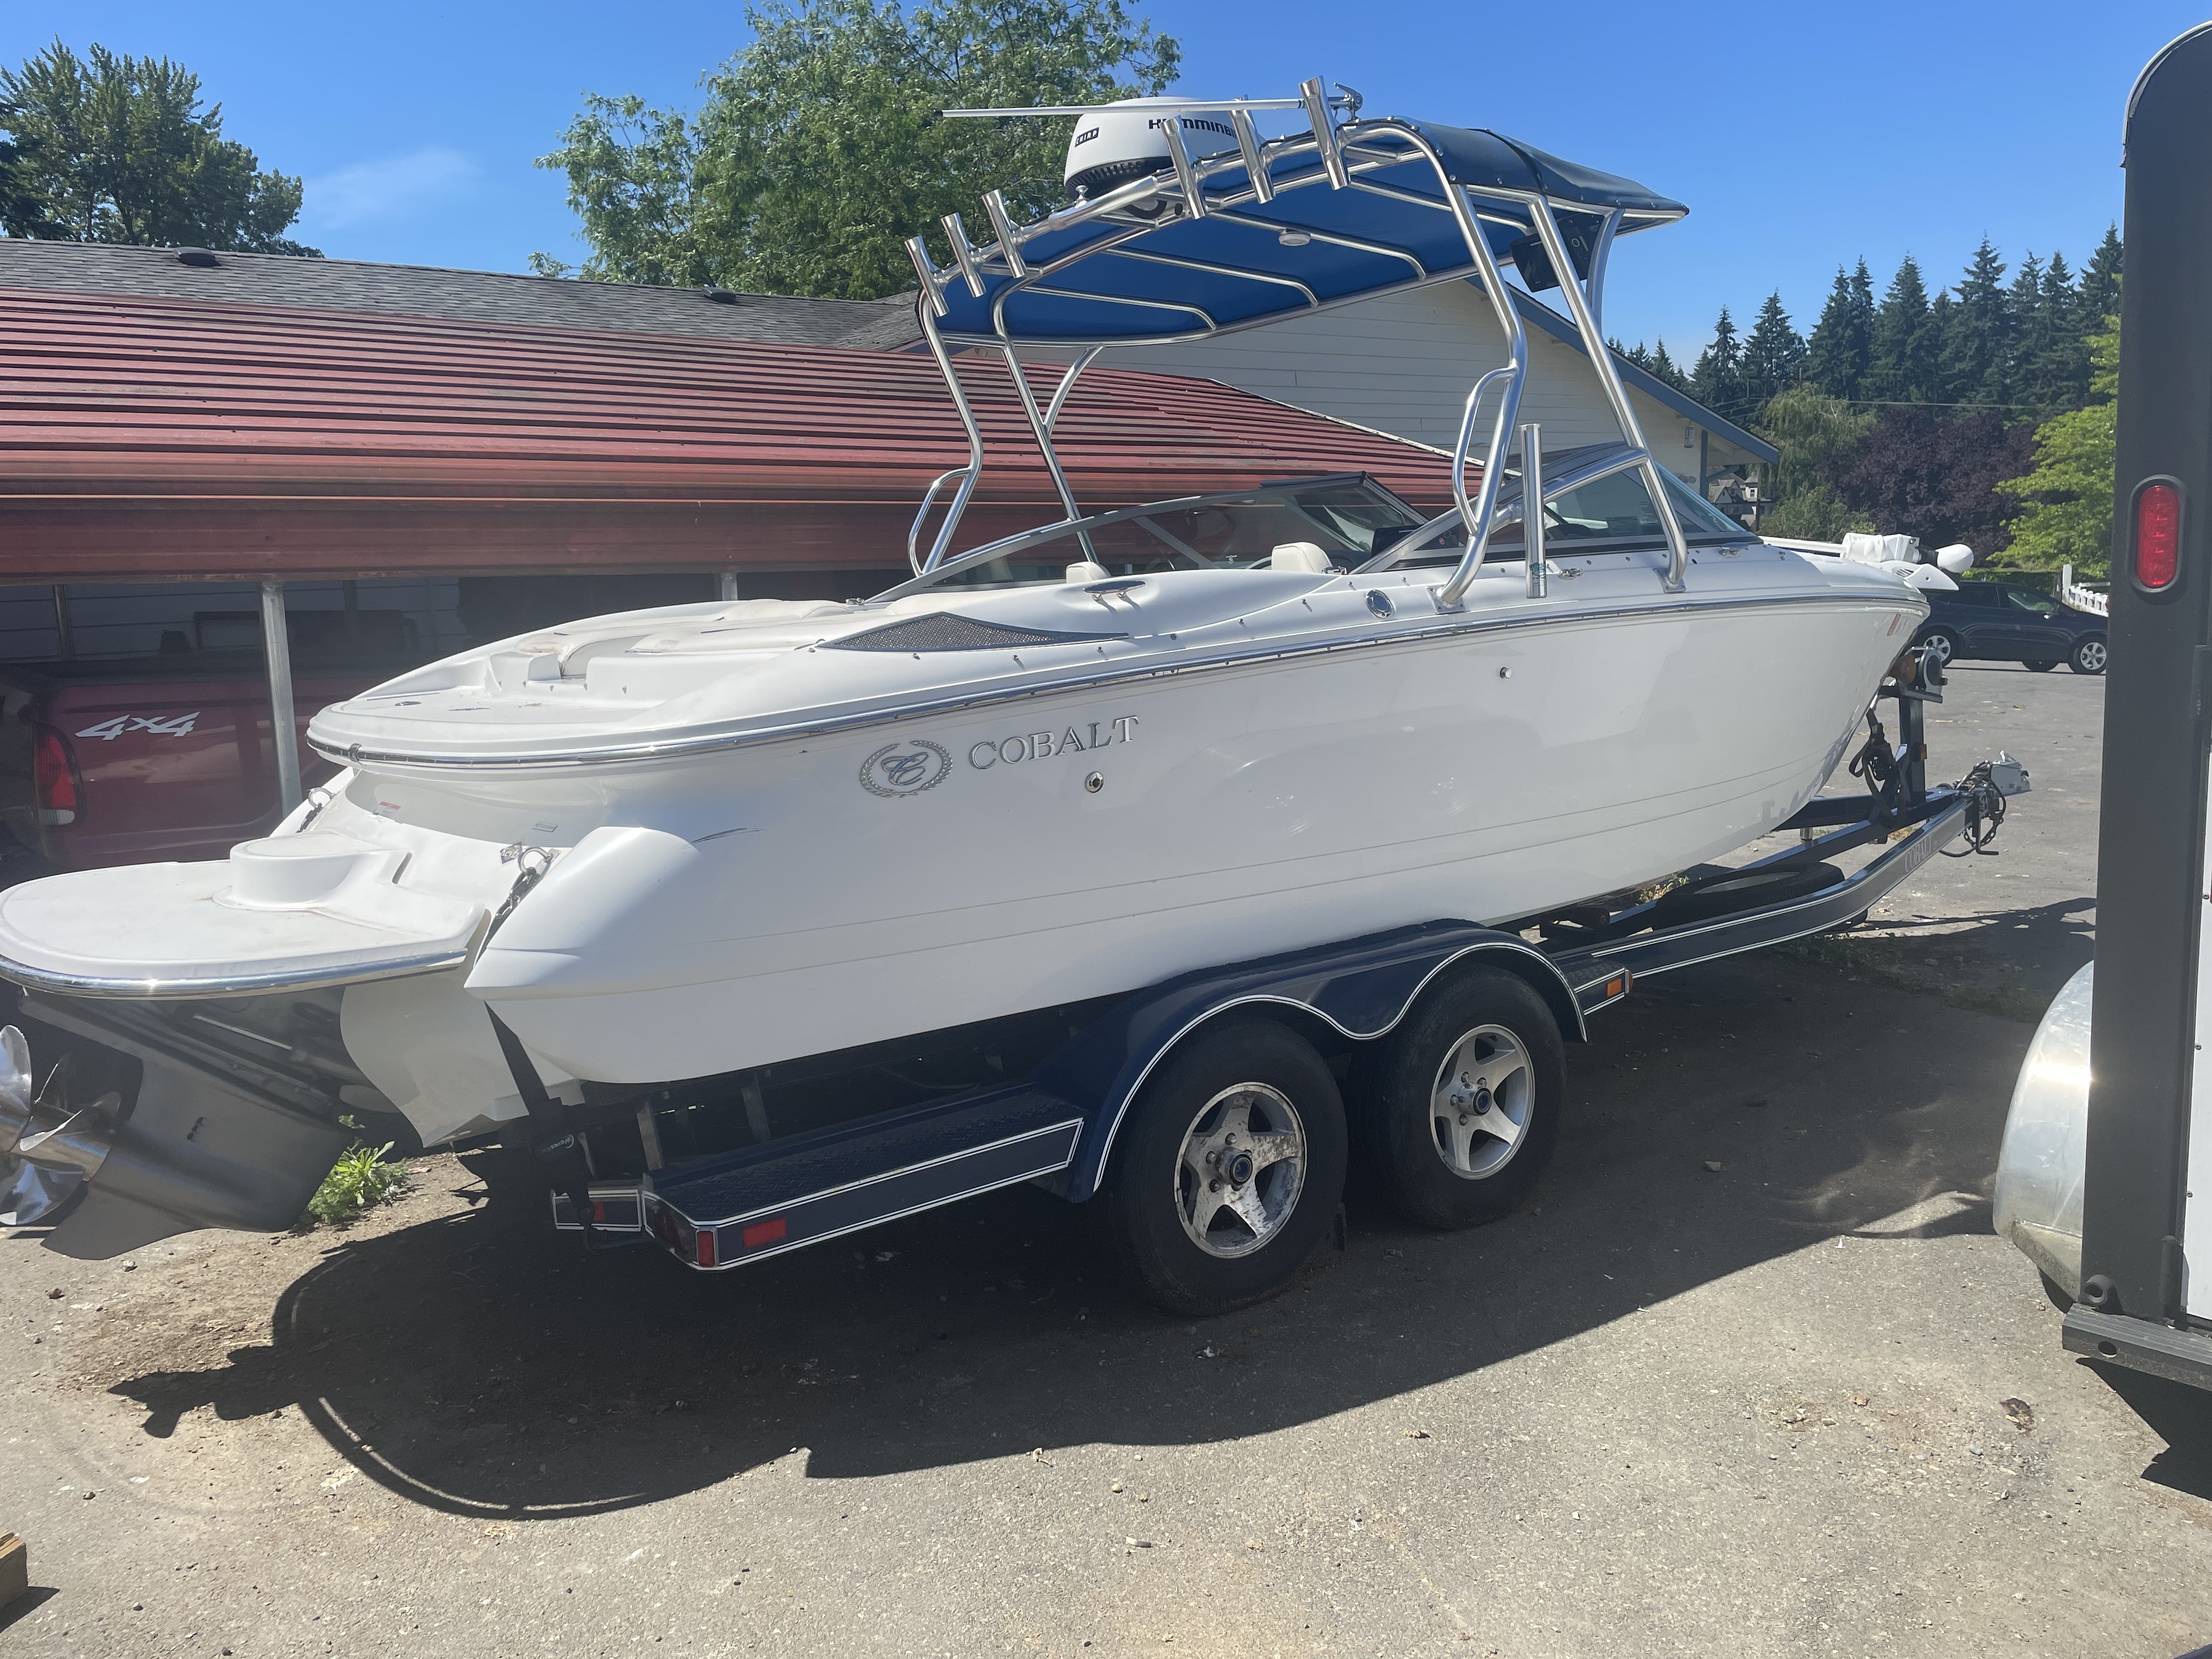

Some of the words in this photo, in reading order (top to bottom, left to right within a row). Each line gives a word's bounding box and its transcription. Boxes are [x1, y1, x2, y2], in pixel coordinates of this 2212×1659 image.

[1076, 129, 1097, 145] CHIRP
[75, 712, 200, 741] 4x4
[969, 715, 1139, 769] COBALT
[1905, 834, 1932, 872] COBALT
